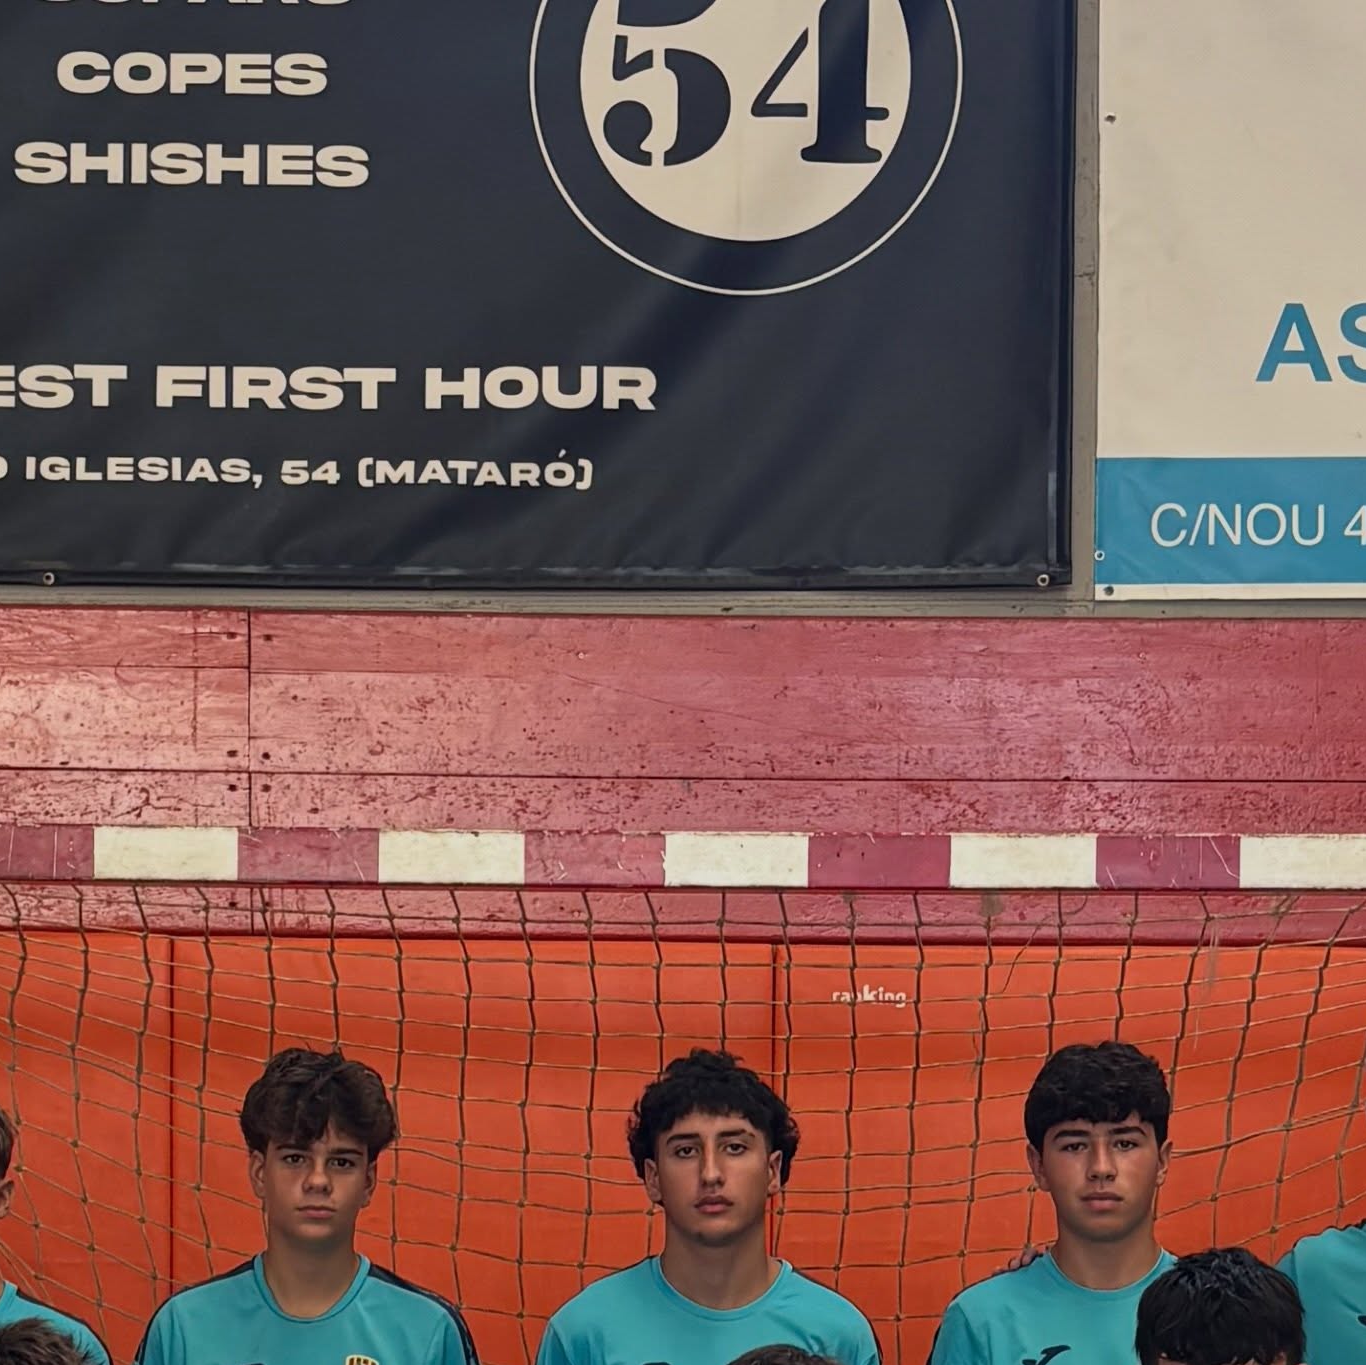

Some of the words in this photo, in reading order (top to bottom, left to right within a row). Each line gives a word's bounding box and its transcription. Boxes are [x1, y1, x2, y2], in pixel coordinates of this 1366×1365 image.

[57, 51, 327, 95] COPES
[603, 0, 889, 167] 54
[15, 142, 368, 187] SHISHES
[156, 366, 396, 409] FIRST
[425, 366, 656, 410] HOUR
[26, 457, 262, 488] IGLESIAS,
[281, 461, 340, 484] 54
[358, 450, 592, 492] (MATARÓ)
[1152, 503, 1324, 546] C/NOU
